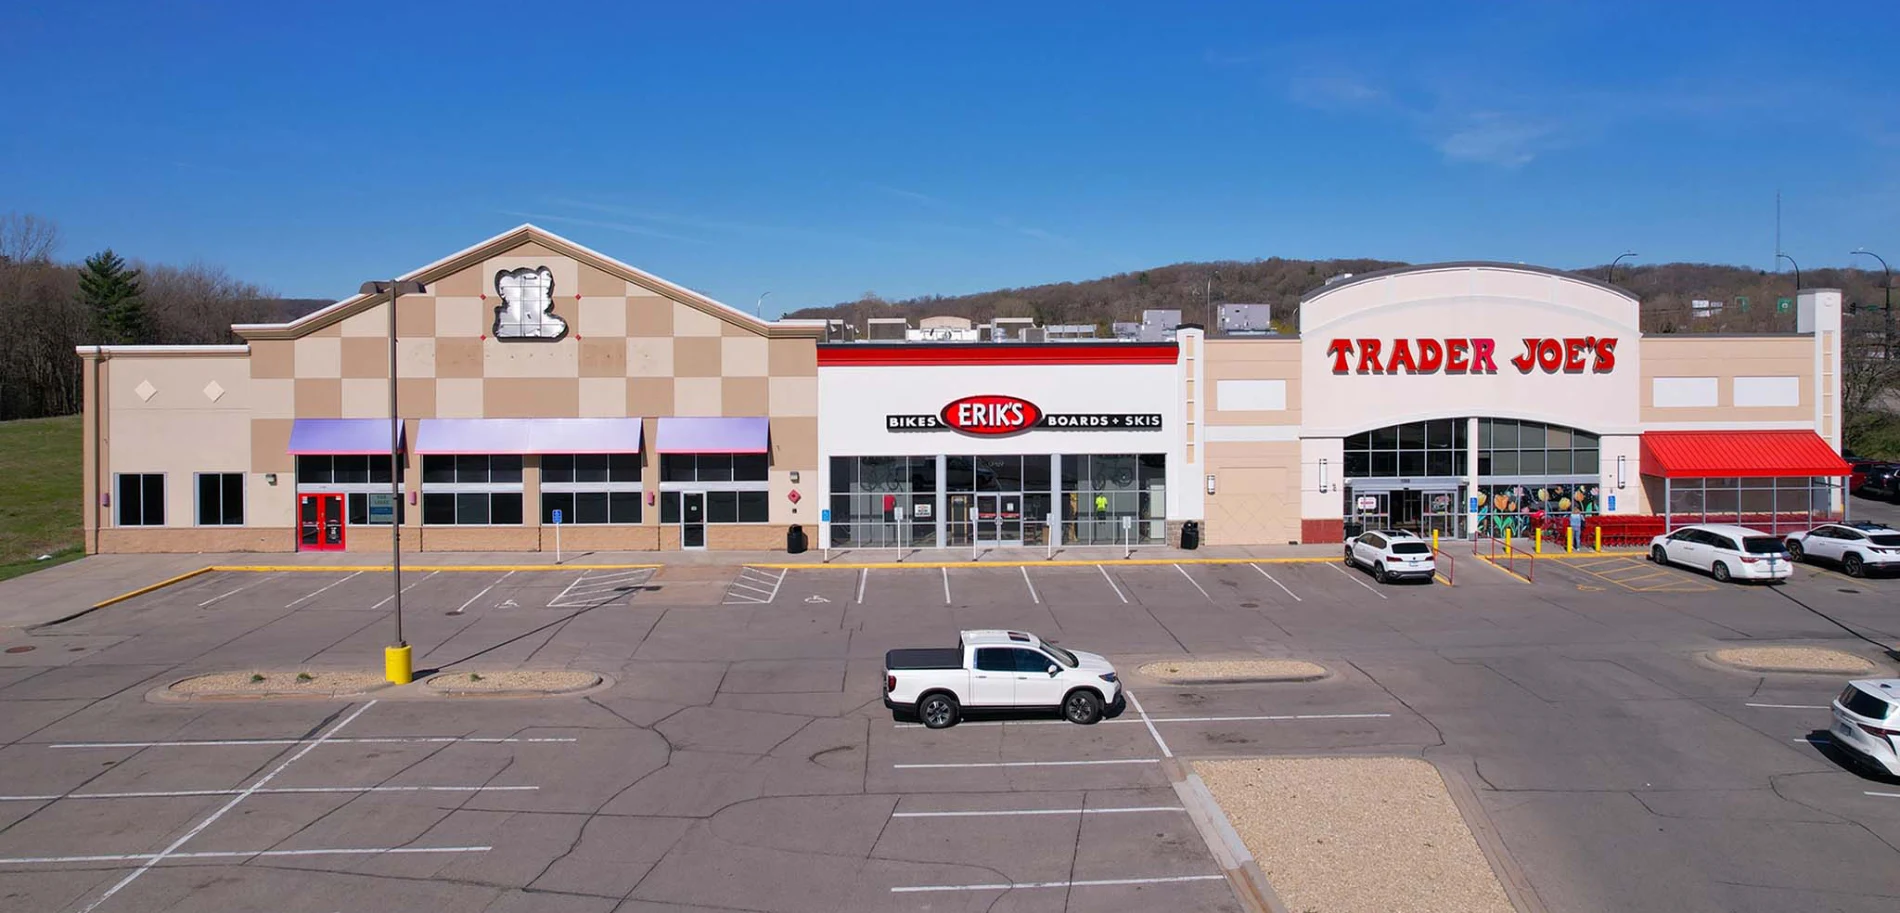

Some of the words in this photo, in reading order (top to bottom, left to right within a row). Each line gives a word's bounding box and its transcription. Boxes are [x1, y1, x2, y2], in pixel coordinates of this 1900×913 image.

[1326, 338, 1498, 375] TRADER
[1510, 336, 1618, 375] JOE'S
[889, 417, 936, 427] BIKES
[958, 402, 1024, 426] ERIK'S
[1048, 416, 1109, 426] BOARDS
[1125, 416, 1160, 426] SKIS
